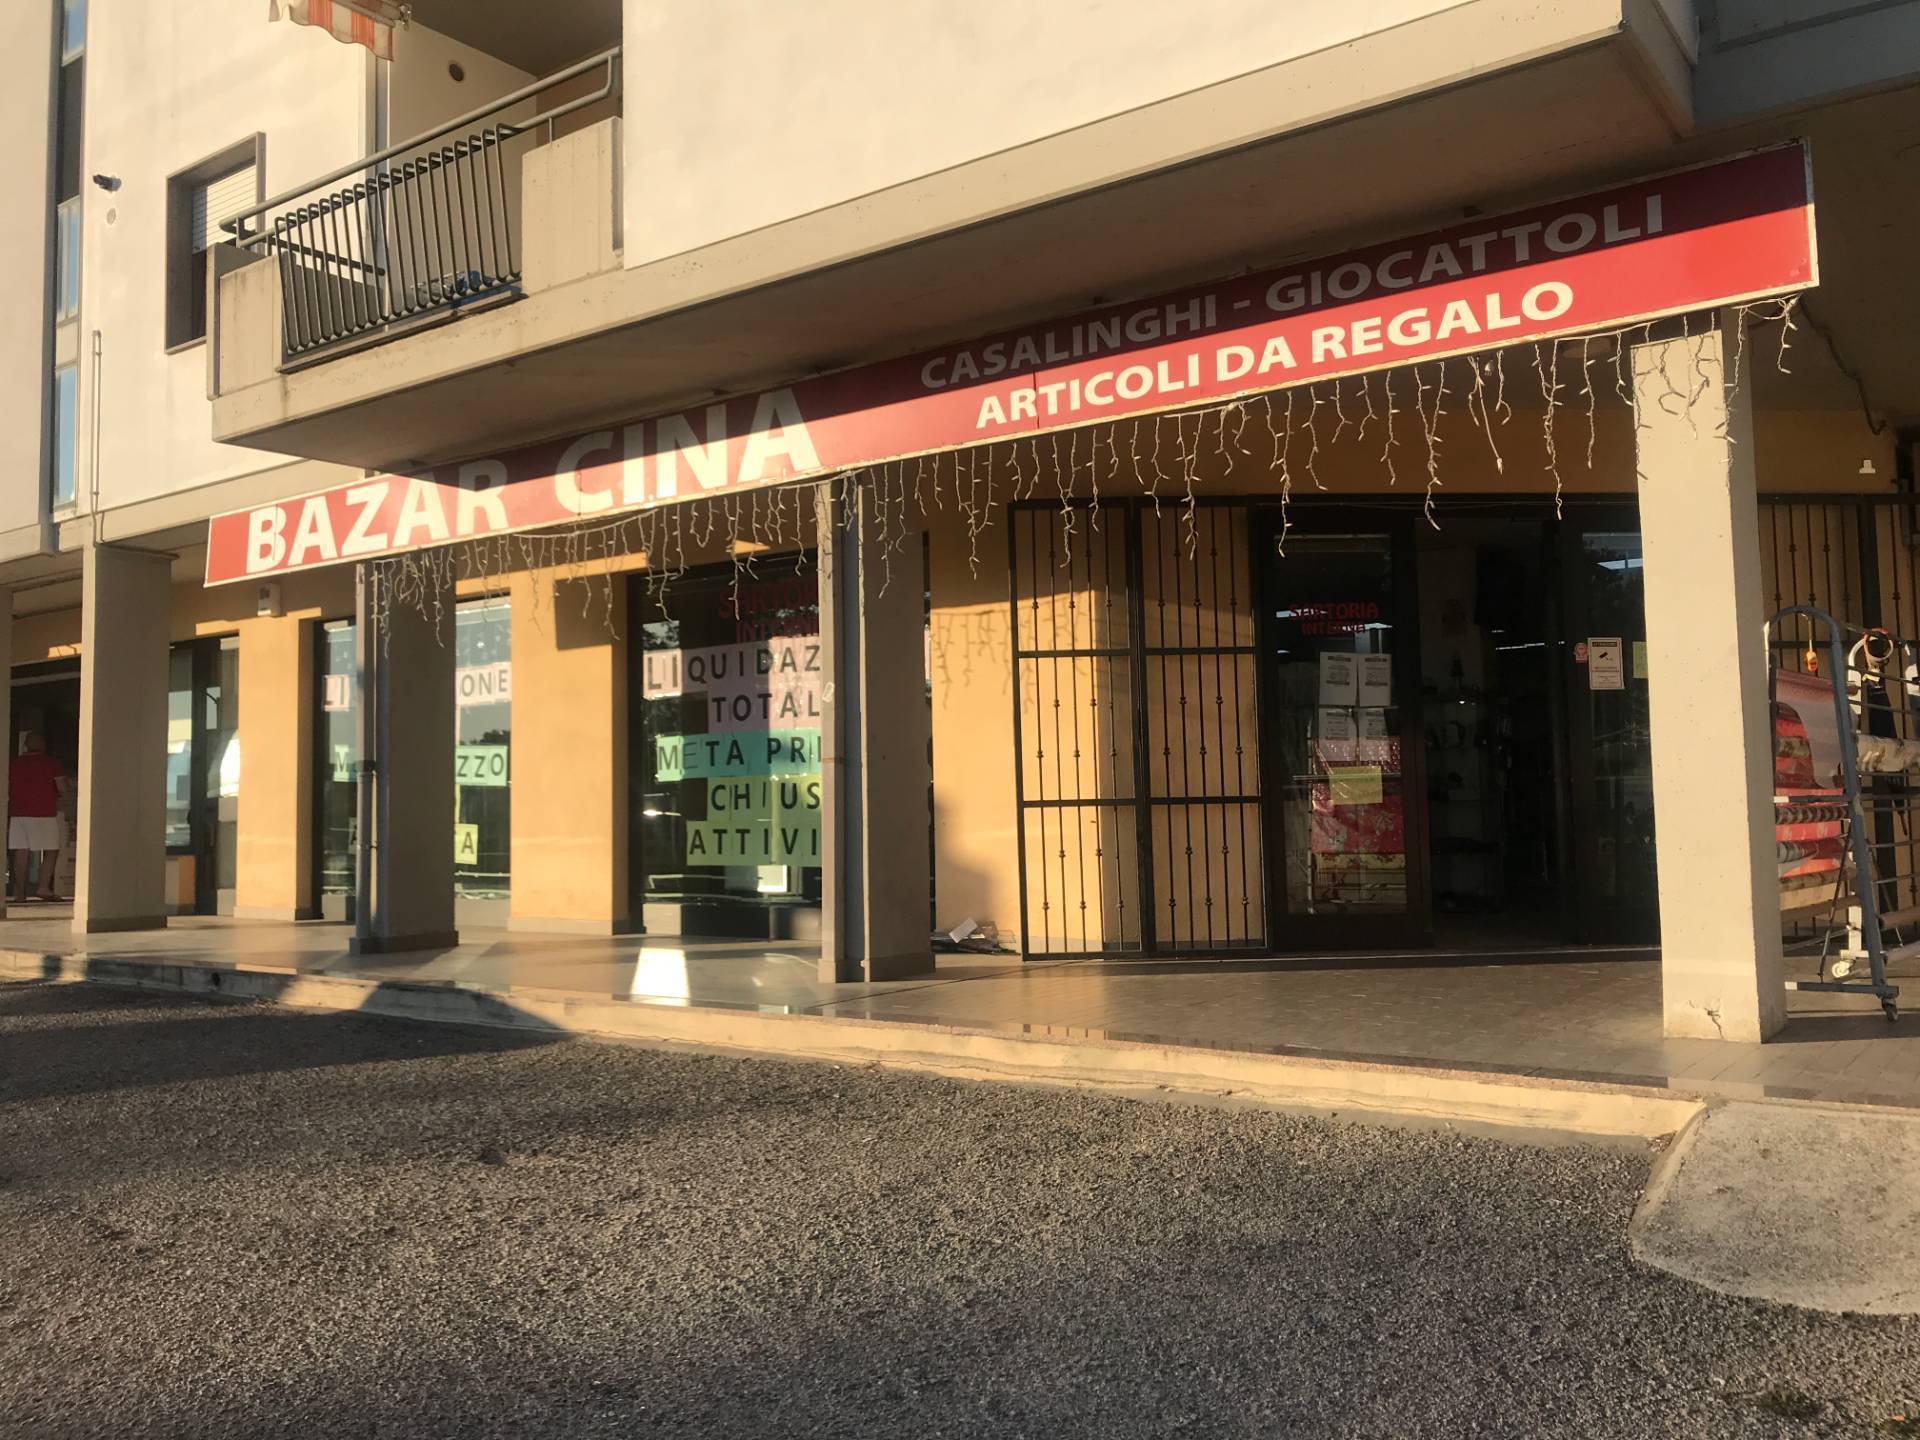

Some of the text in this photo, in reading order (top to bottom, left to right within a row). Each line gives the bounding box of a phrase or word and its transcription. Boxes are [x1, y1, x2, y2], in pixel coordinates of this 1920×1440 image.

[920, 295, 1217, 389] CASALINGHI
[1265, 194, 1663, 313] GIOCATTOLI
[975, 281, 1574, 429] ARTICOLI DA REGALO
[246, 387, 820, 574] BAZAR CINA
[658, 739, 744, 771] META
[689, 828, 817, 856] ATTIVI
